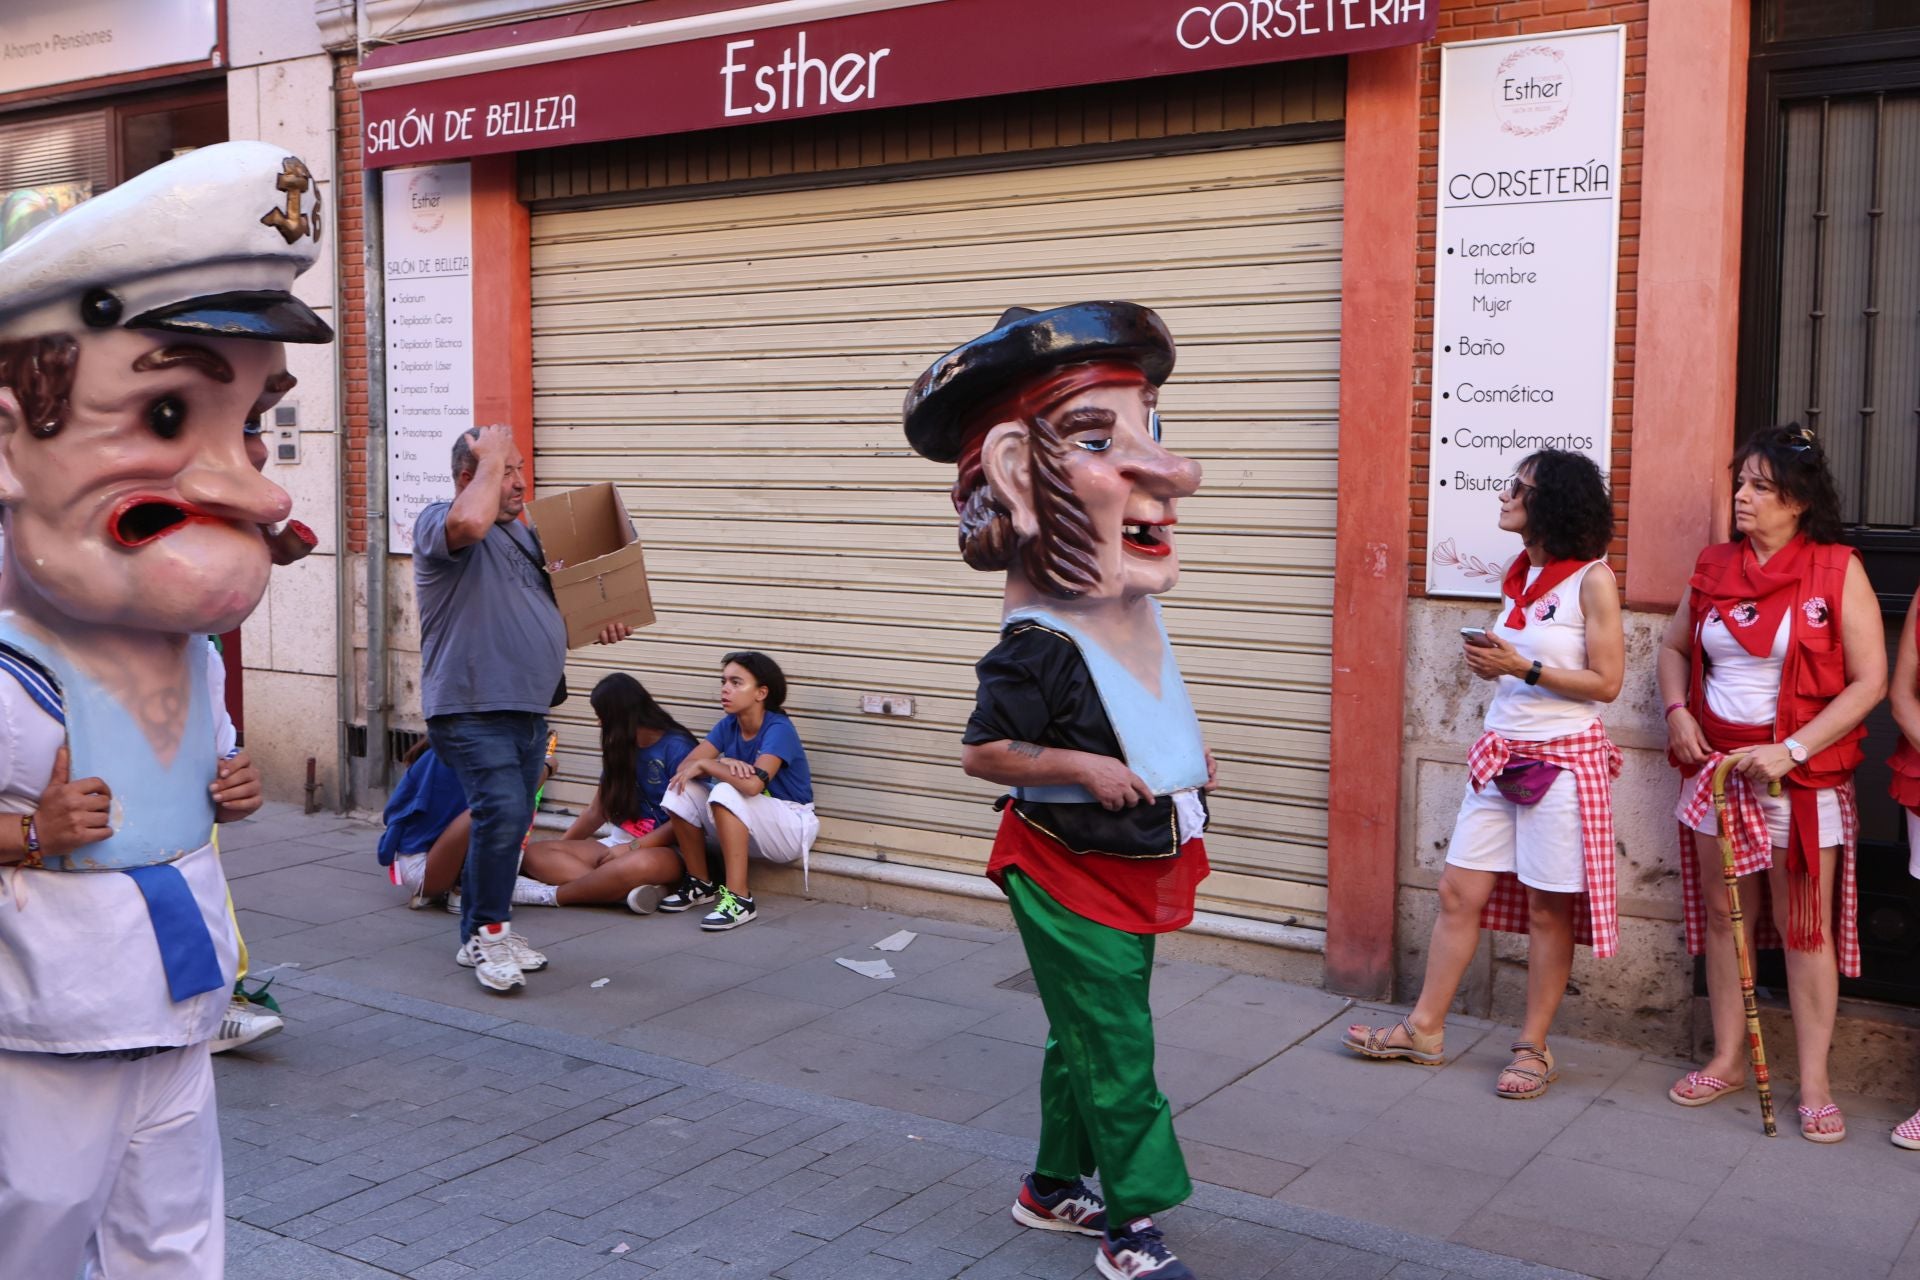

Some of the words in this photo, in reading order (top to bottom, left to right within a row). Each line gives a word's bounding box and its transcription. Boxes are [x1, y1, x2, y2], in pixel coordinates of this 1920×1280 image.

[3, 41, 42, 60] Ahorro
[52, 29, 113, 51] Pensiones
[720, 32, 890, 118] Esther
[1503, 77, 1562, 101] Esther
[367, 108, 434, 154] SALÓN
[444, 108, 476, 142] DE
[486, 94, 576, 137] BELLEZA
[1449, 159, 1609, 200] CORSETERÍA
[412, 192, 440, 209] Esther
[1461, 237, 1535, 258] Lencería
[388, 258, 415, 275] SALÓN
[419, 259, 430, 273] DE
[435, 257, 469, 272] BELLEZA
[1475, 267, 1537, 286] Hombre
[1473, 295, 1512, 318] Mujer
[1459, 336, 1505, 356] Baño
[430, 383, 449, 394] Facial
[1456, 382, 1554, 403] Cosmética
[401, 405, 441, 416] Tratamientos
[444, 405, 469, 416] Faciales
[1454, 428, 1593, 455] Complementos
[1455, 471, 1515, 492] Bisuterí
